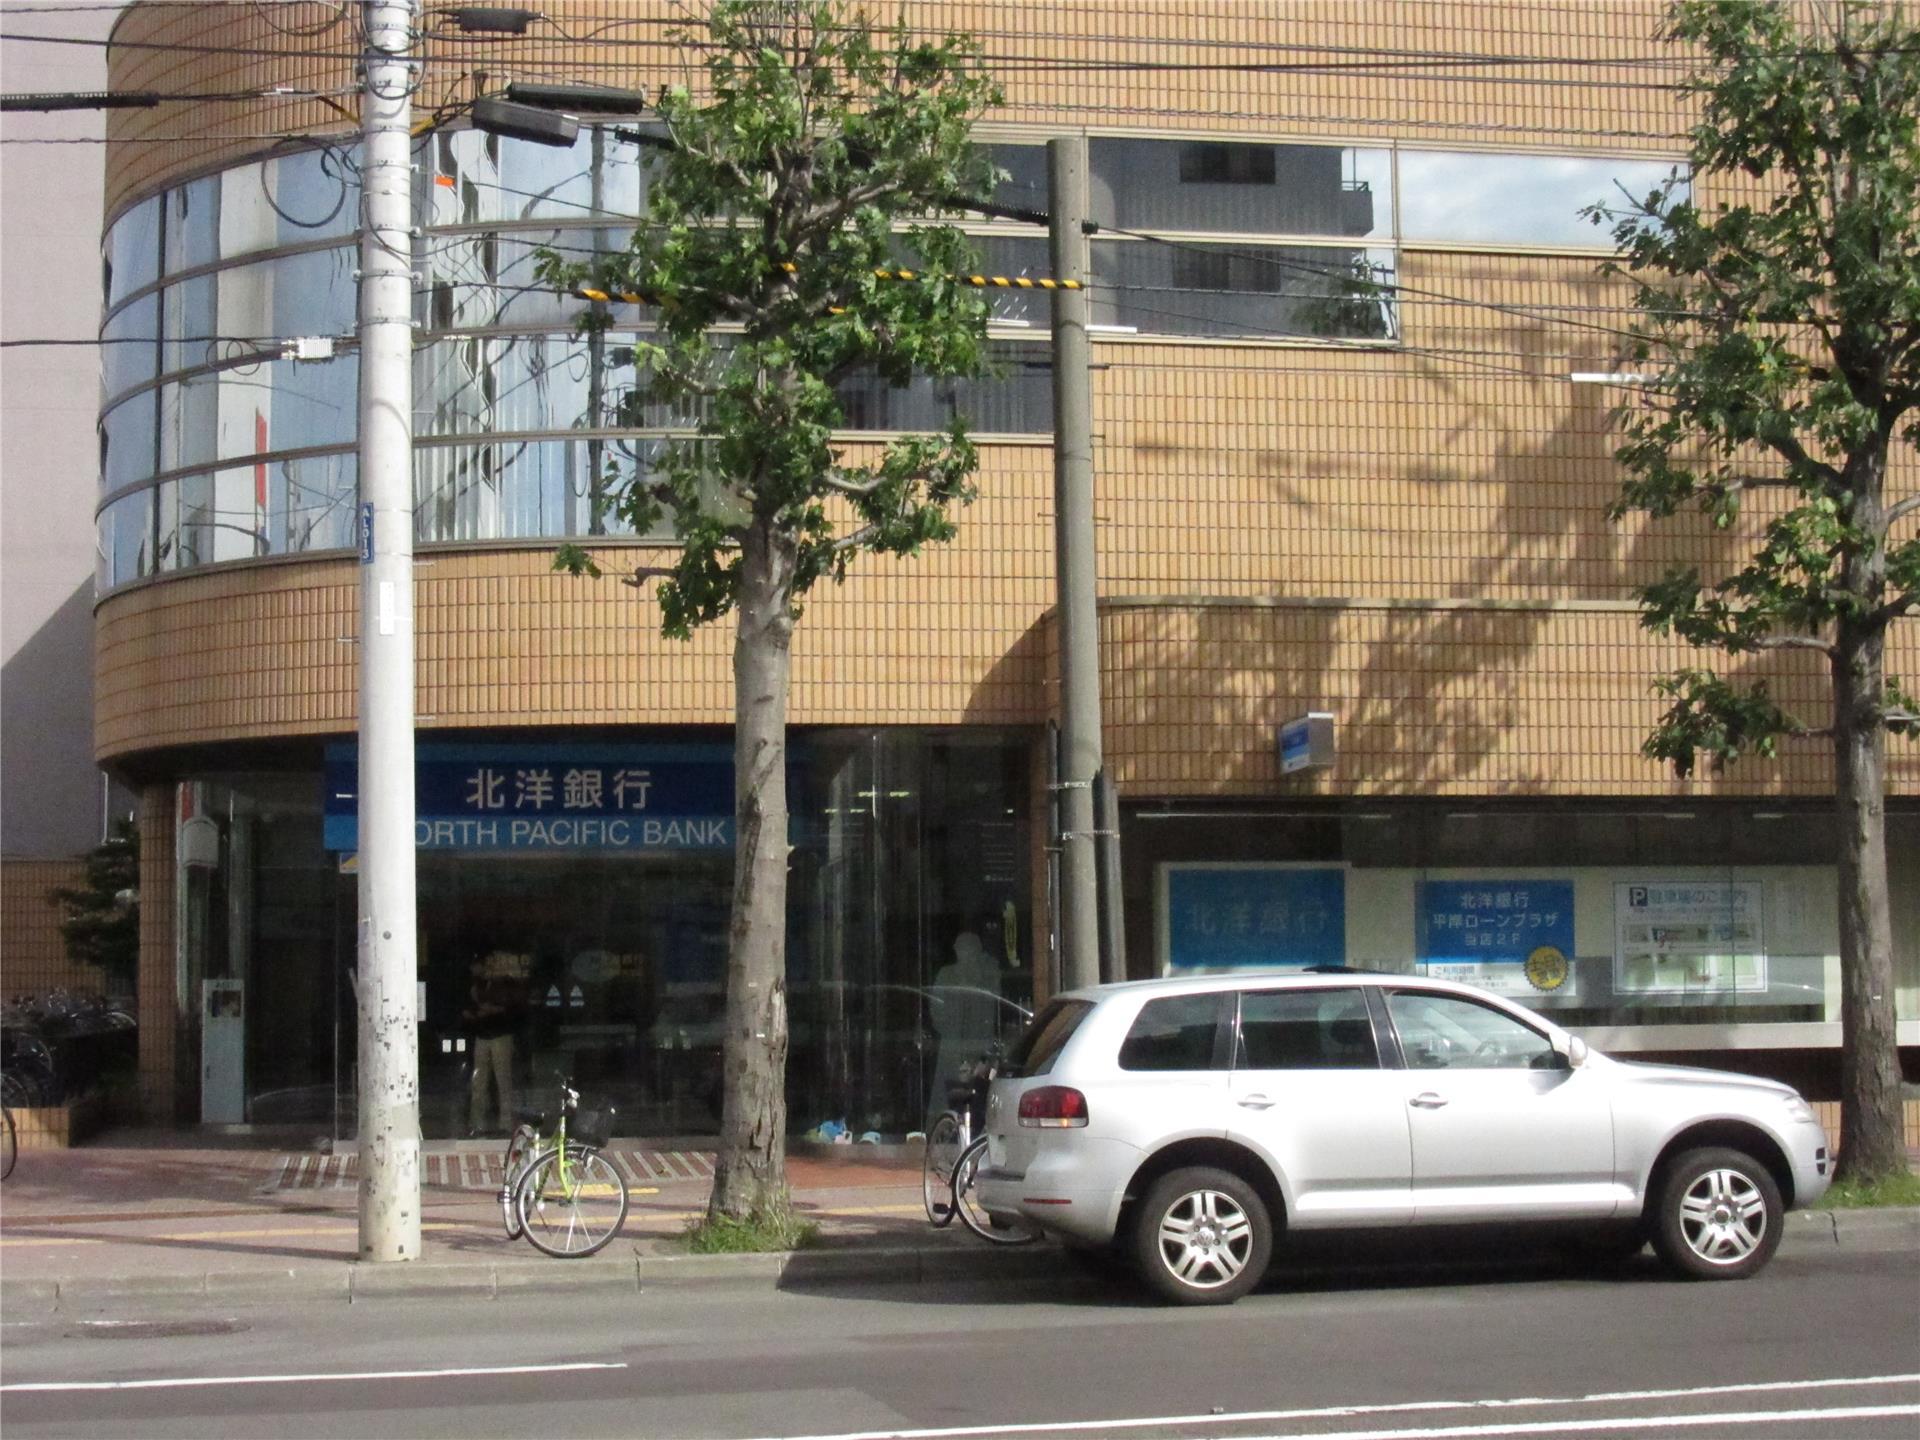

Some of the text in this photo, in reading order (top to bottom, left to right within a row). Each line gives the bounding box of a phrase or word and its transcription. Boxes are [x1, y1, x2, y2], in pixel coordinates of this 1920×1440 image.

[466, 769, 652, 809] 北洋銀行
[414, 819, 728, 846] ORTH PACIFIC BANK
[1460, 890, 1530, 909] 北洋銀行
[1432, 912, 1560, 929] 平岸ローンプラザ
